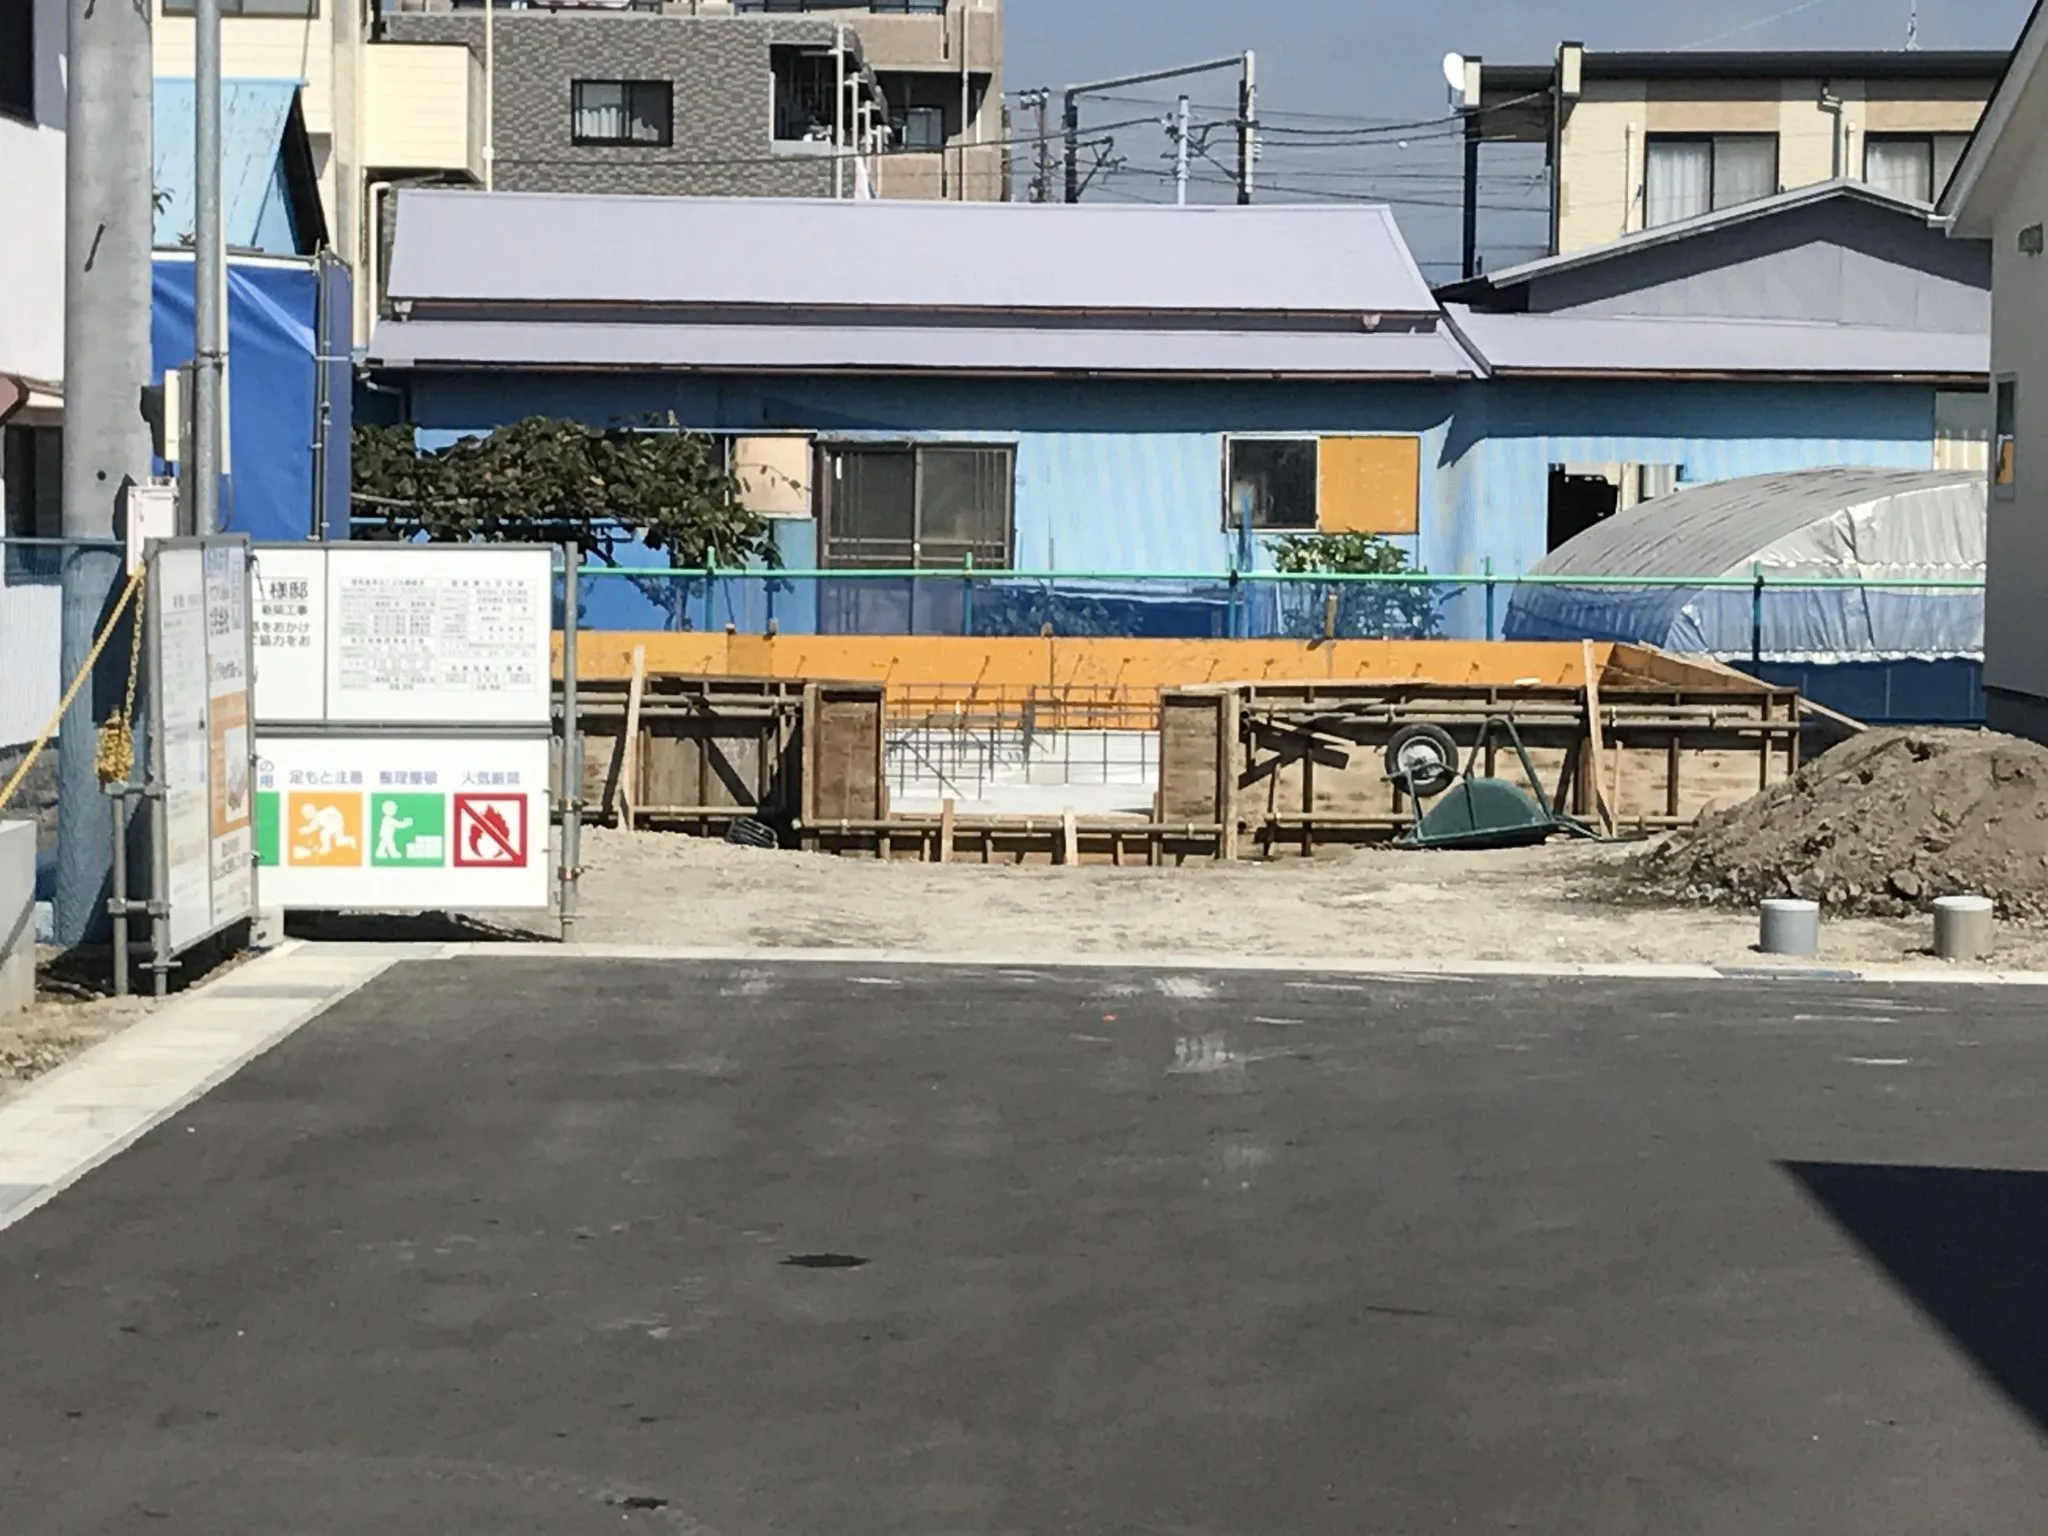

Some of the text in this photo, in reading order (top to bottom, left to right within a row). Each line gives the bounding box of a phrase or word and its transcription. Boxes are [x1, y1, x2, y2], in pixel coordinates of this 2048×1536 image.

[270, 582, 308, 599] 様邸
[289, 770, 363, 785] 足もと注意
